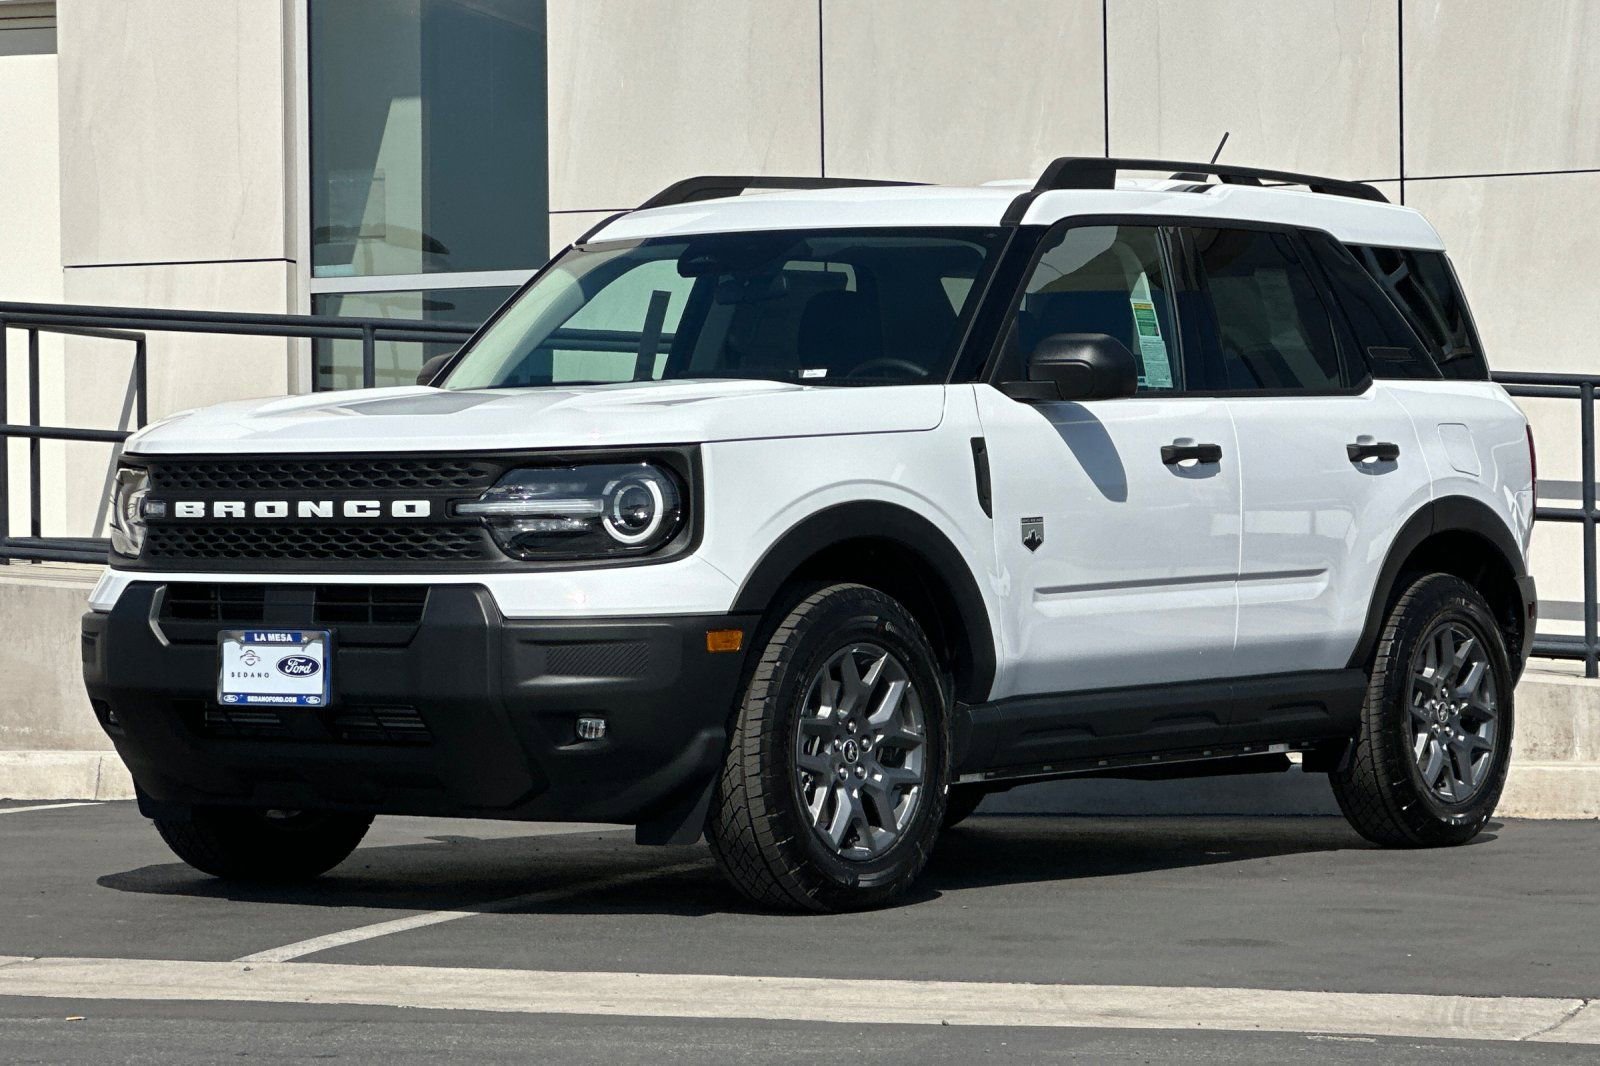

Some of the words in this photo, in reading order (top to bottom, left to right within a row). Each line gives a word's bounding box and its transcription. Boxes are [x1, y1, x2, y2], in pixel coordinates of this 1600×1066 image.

[175, 500, 431, 518] BRONCO
[254, 633, 266, 642] LA
[268, 633, 293, 642] MESA
[286, 658, 312, 674] Ford
